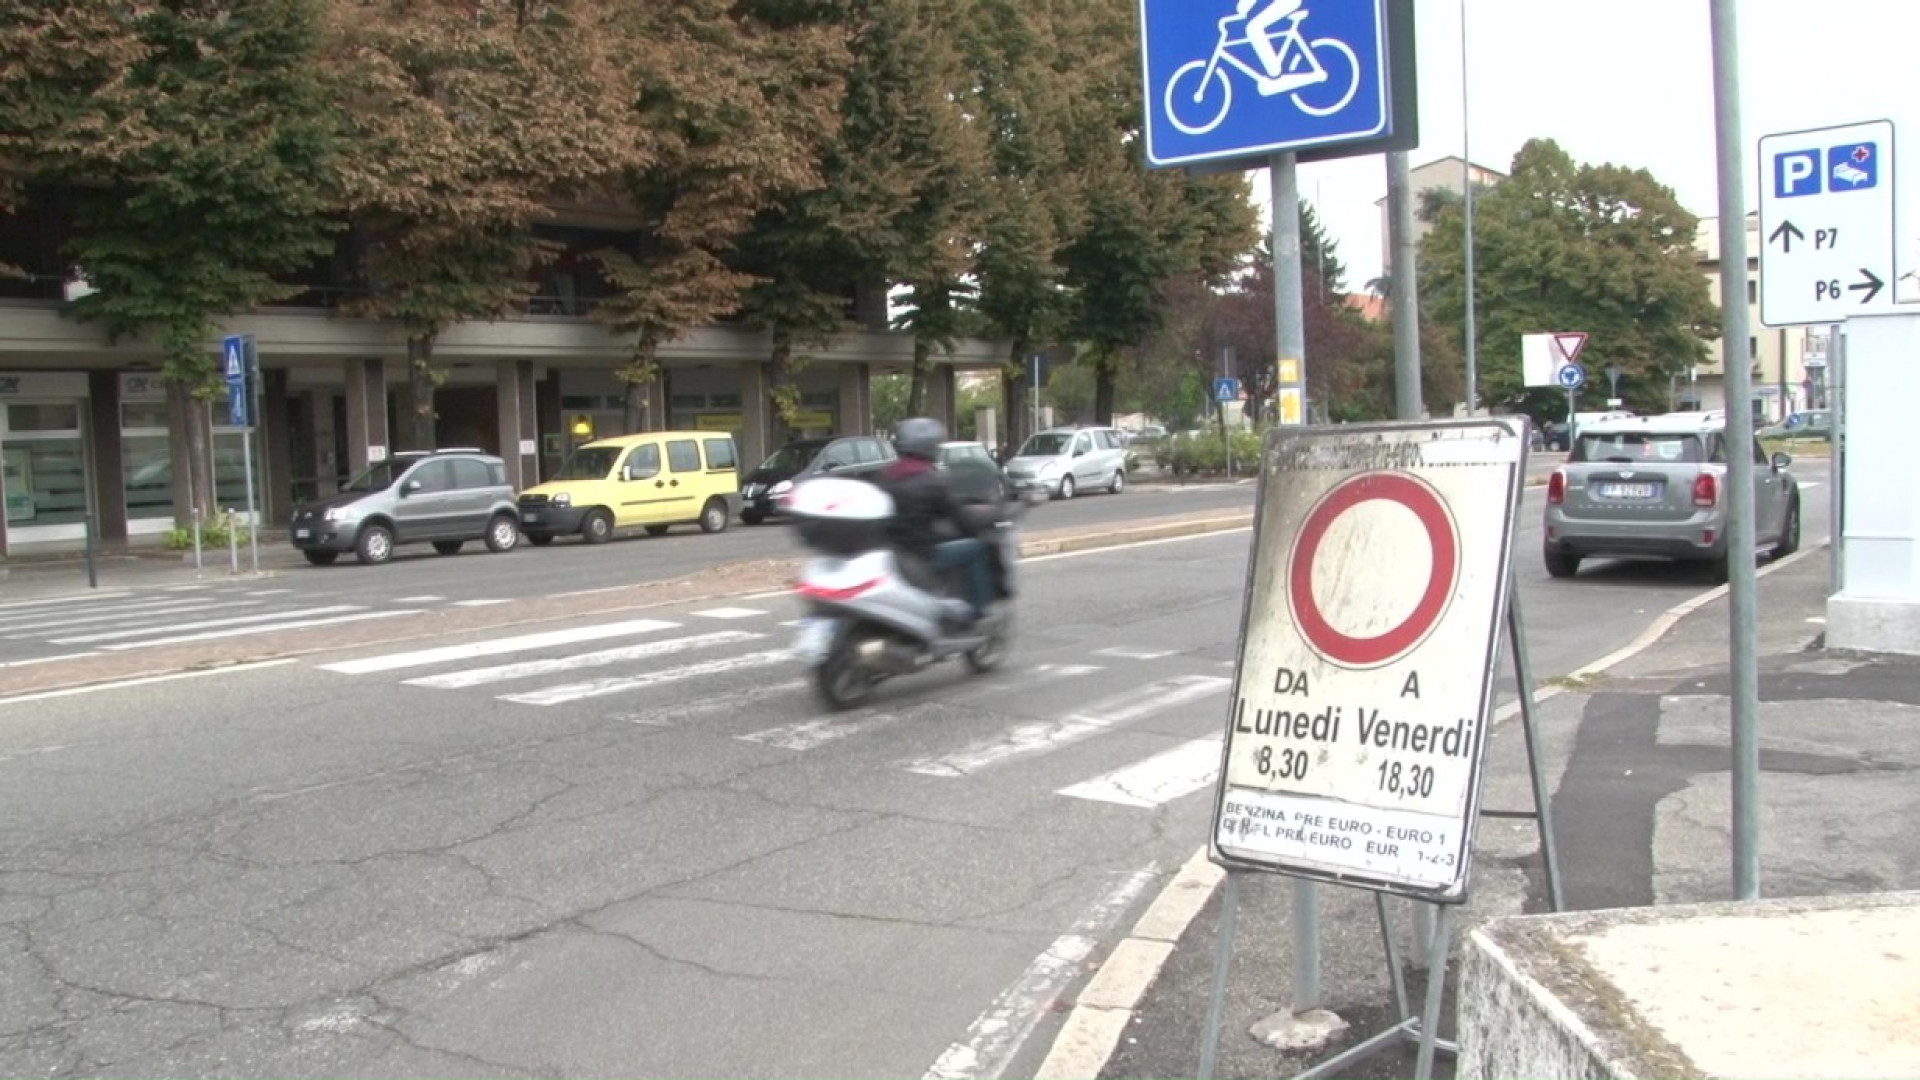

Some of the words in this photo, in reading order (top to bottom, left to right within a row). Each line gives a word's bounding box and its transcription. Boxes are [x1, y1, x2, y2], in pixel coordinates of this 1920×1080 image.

[1783, 155, 1813, 194] P
[1815, 228, 1838, 250] P7
[1815, 279, 1841, 301] P6
[1273, 667, 1310, 698] DA
[1400, 670, 1421, 699] A
[1235, 697, 1343, 743] Lunedi
[1357, 706, 1474, 758] Venerdi
[1257, 745, 1309, 781] 8,30
[1377, 759, 1435, 799] 18,30
[1225, 801, 1286, 822] BENZINA
[1328, 817, 1373, 835] EURO
[1386, 826, 1433, 844] EURO
[1439, 834, 1446, 846] 1
[1308, 832, 1353, 850] EURO
